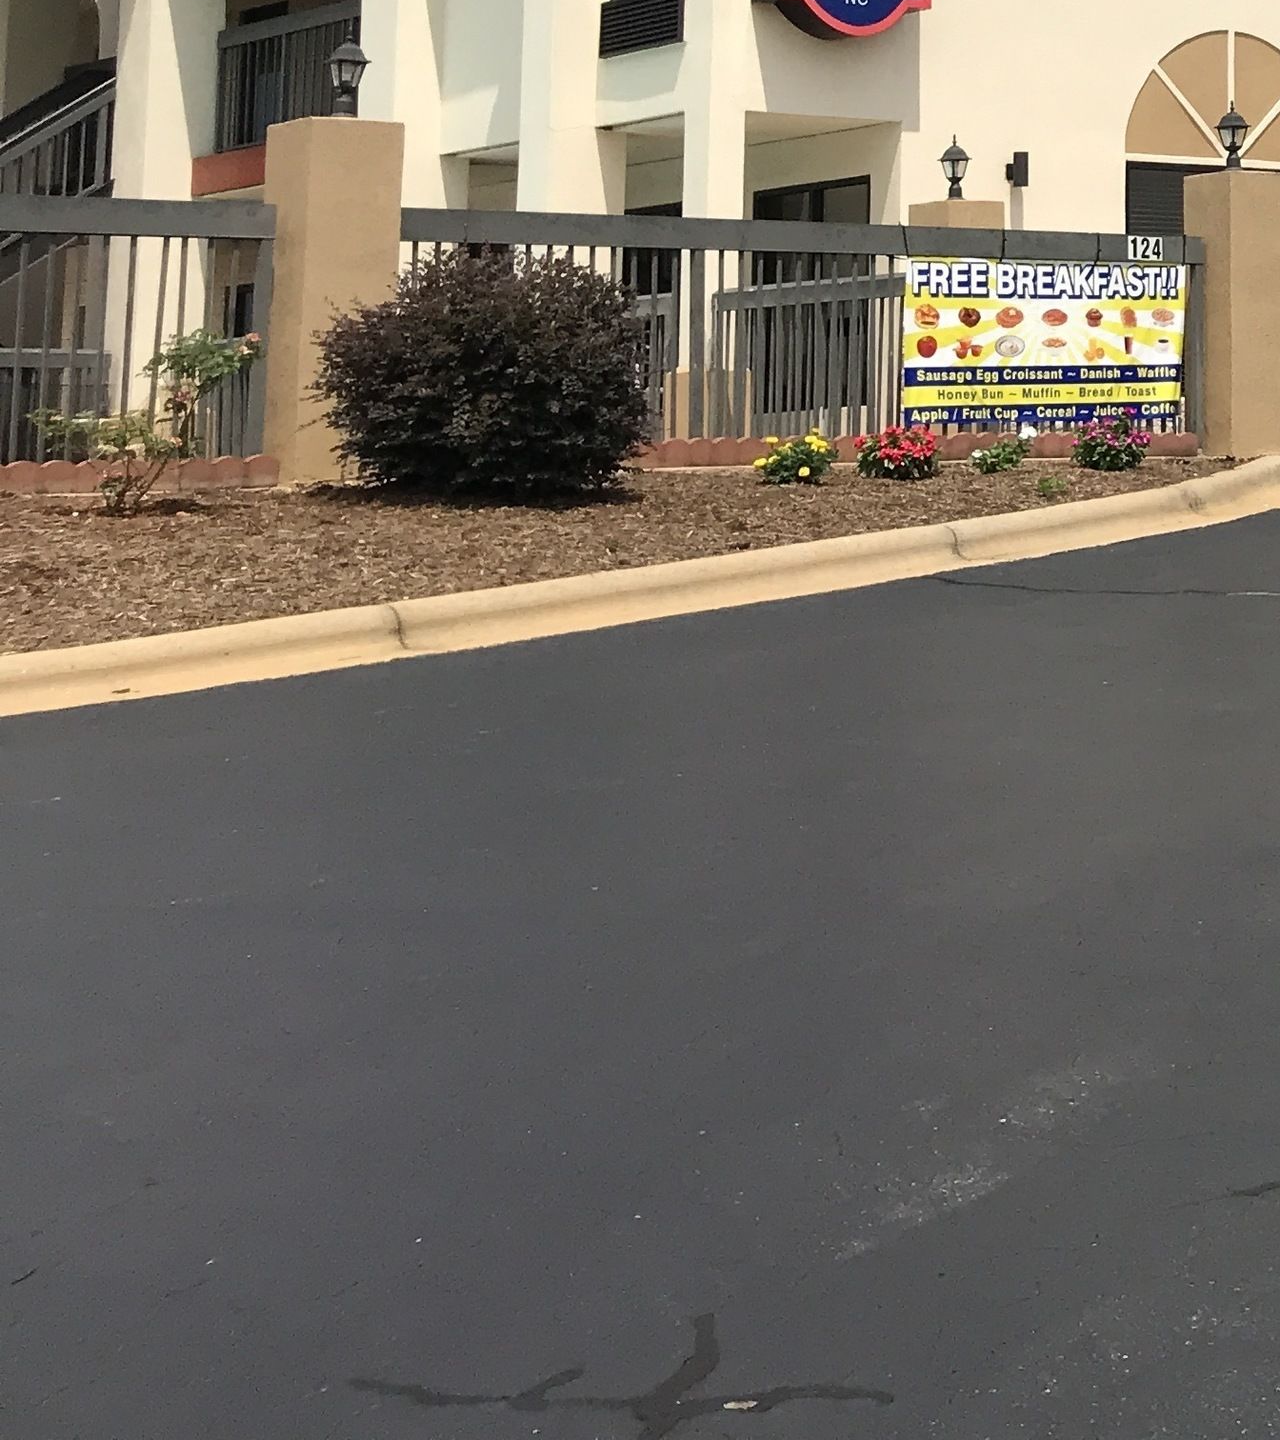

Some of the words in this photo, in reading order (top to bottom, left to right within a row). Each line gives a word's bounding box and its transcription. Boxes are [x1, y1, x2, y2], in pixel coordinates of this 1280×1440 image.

[1129, 236, 1162, 260] 124
[911, 261, 989, 297] FREE
[995, 262, 1180, 300] BREAKFAST!!
[916, 369, 972, 383] Sausage
[976, 369, 999, 383] Egg
[1003, 368, 1063, 381] Croissant
[1080, 367, 1121, 379] Danish
[1136, 366, 1177, 378] Waffle
[937, 389, 977, 401] Honey
[982, 389, 1004, 400] Bun
[1022, 387, 1061, 399] Muffin
[1079, 387, 1113, 398] Bread
[1126, 386, 1157, 396] Toast
[911, 408, 949, 422] Apple
[962, 408, 991, 420] Fruit
[994, 408, 1019, 421] Cup
[1036, 406, 1077, 418] Cereal
[1092, 405, 1124, 417] Juice
